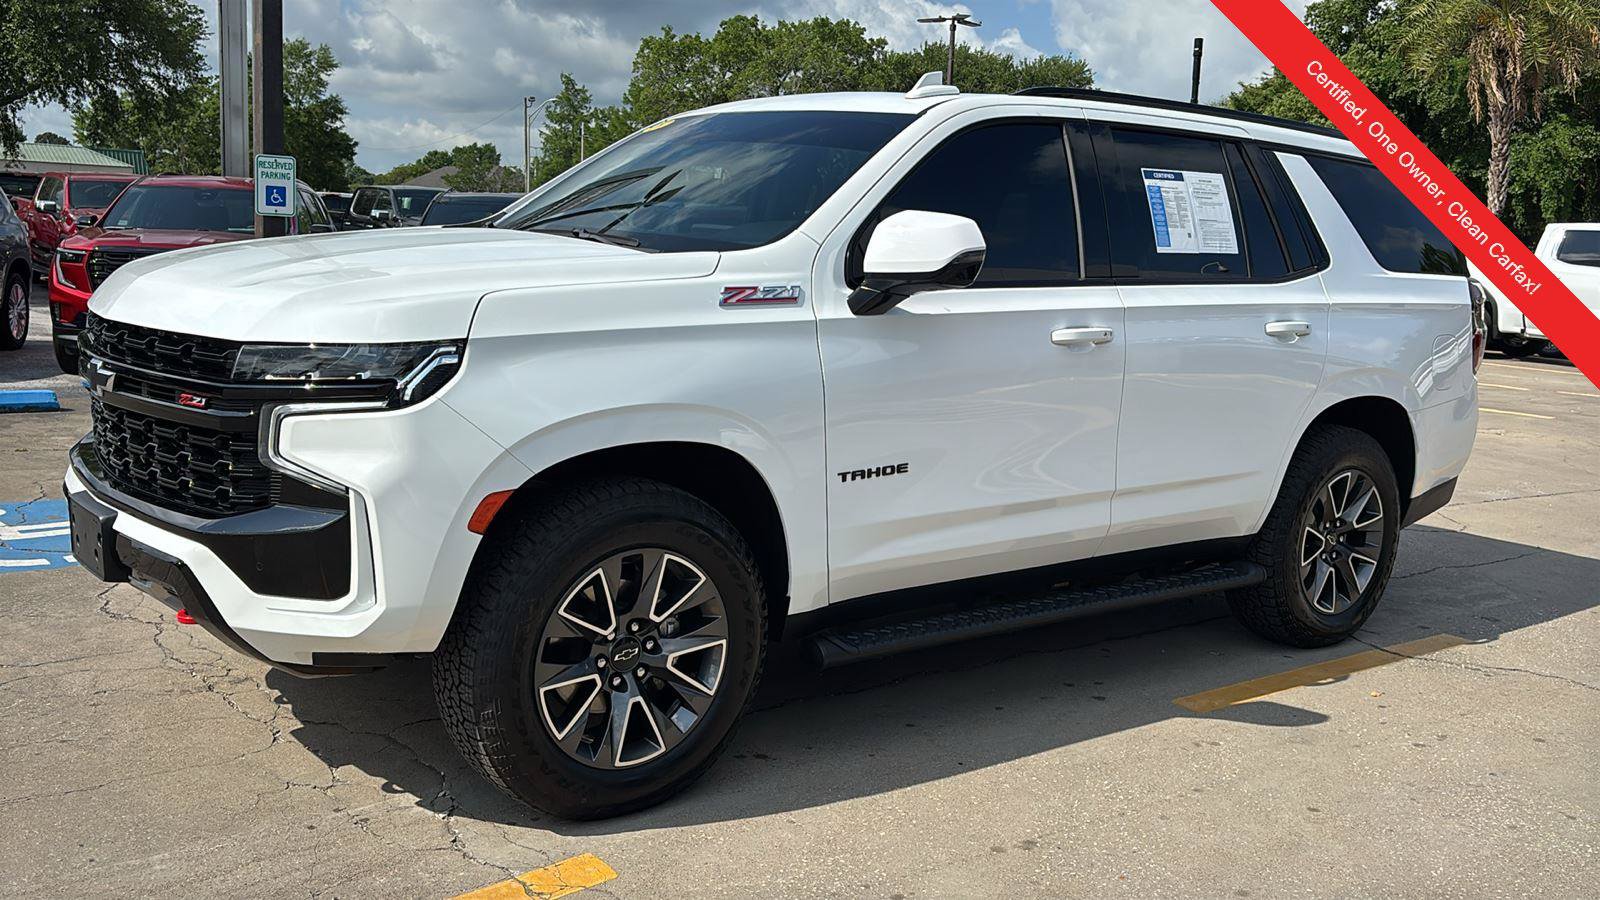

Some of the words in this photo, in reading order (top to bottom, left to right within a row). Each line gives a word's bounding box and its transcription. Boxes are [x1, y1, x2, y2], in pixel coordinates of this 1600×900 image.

[258, 160, 293, 171] RESERVED
[260, 170, 291, 181] PARKING
[837, 462, 909, 483] TAHOE
